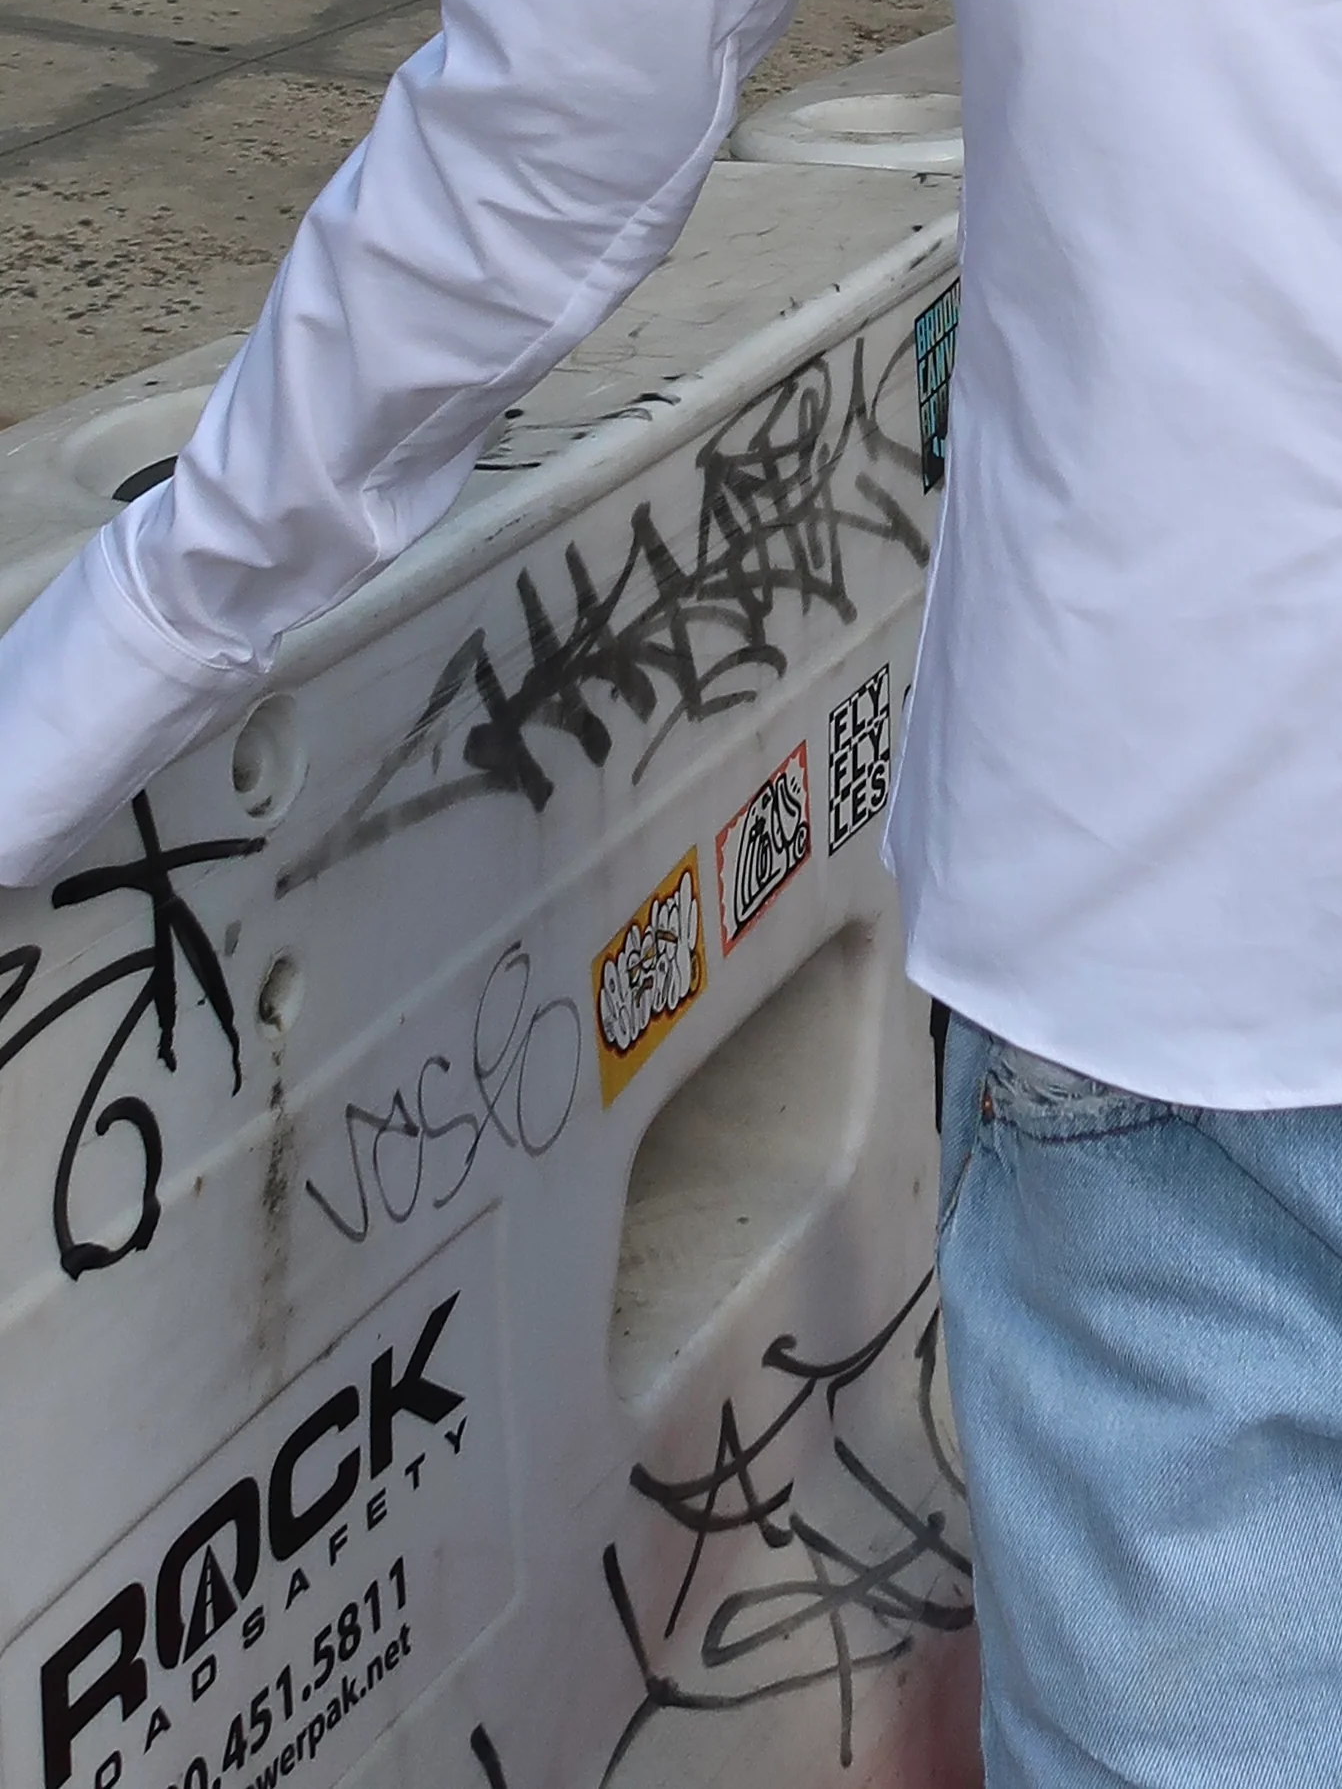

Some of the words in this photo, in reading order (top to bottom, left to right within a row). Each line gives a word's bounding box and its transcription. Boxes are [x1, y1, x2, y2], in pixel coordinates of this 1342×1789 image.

[833, 672, 885, 753] FLY
[833, 719, 885, 799] FLY
[833, 761, 888, 842] LES
[41, 1289, 466, 1789] ROCK
[166, 1557, 408, 1789] 0.451.5811
[246, 1623, 412, 1789] werpak.net
